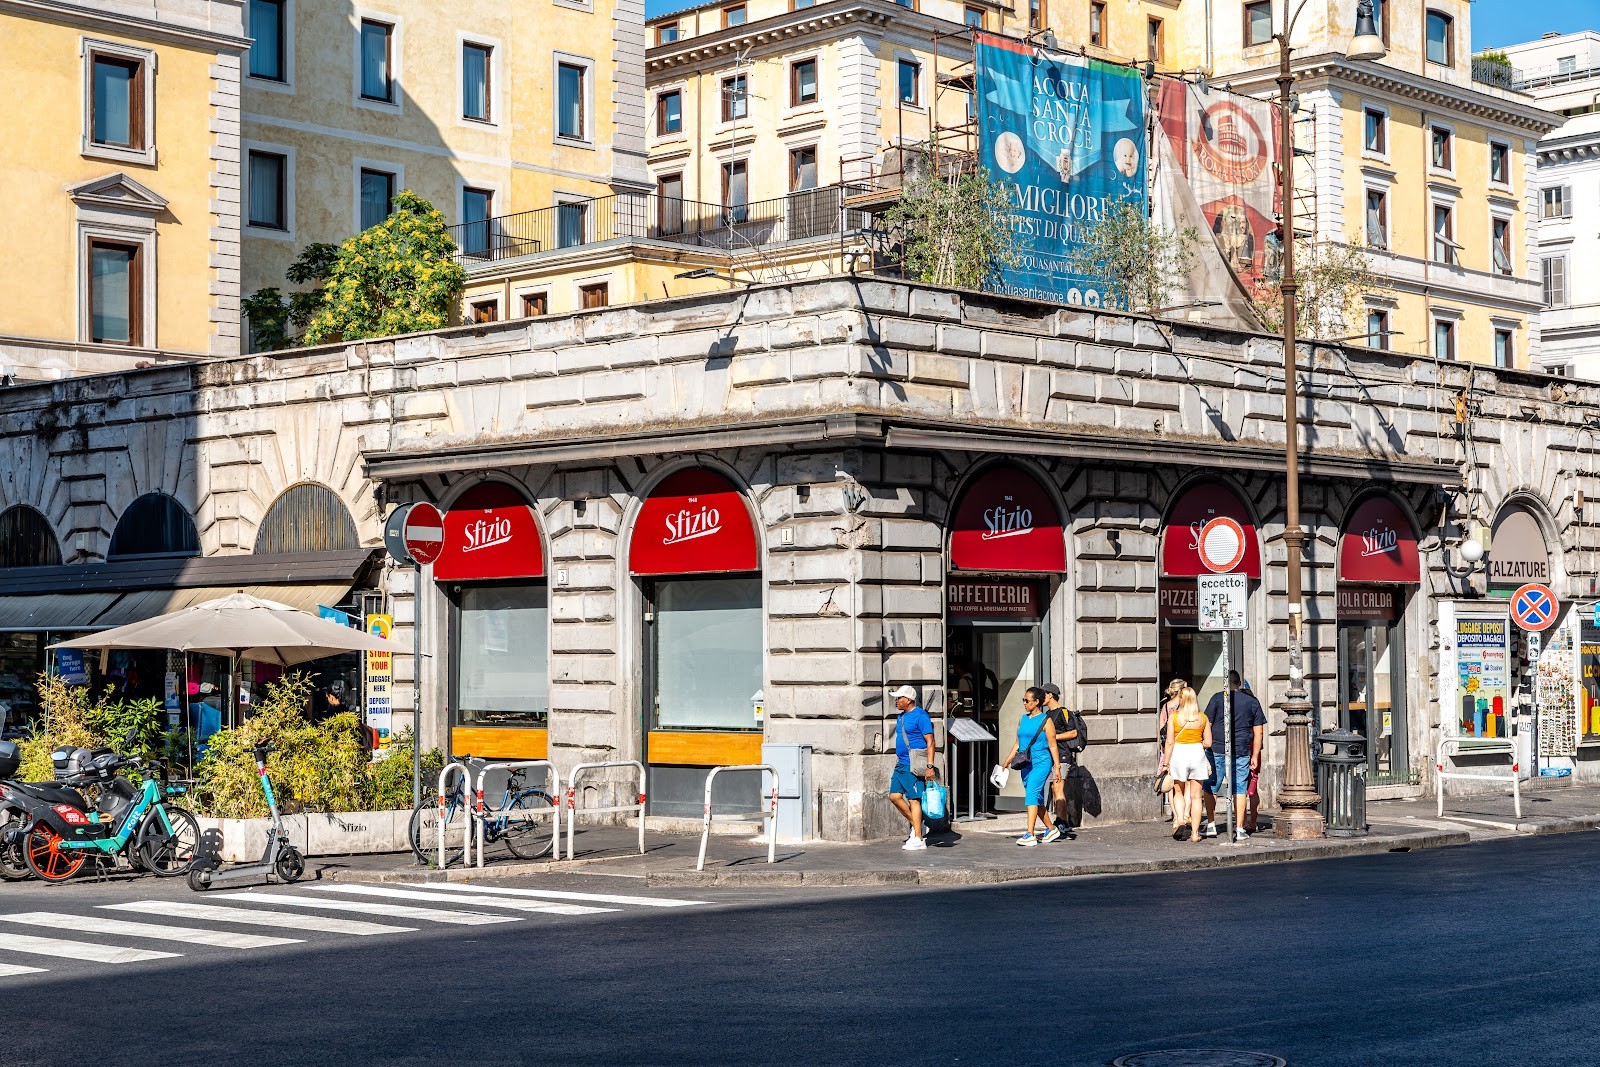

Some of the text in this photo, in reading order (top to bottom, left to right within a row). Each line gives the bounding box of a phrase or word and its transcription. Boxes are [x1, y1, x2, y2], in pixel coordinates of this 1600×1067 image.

[1033, 75, 1090, 104] ACQUA
[1033, 97, 1091, 128] SANTA
[1033, 120, 1093, 149] CROCE
[1199, 149, 1229, 181] ROMA
[1007, 214, 1042, 236] TEST
[1044, 220, 1057, 239] DI
[462, 516, 513, 552] Sfizio
[663, 506, 722, 545] Sfizio
[982, 505, 1034, 540] Sfizio
[1361, 526, 1398, 557] Sfizio
[948, 585, 1030, 603] AFFETTERIA
[1201, 576, 1244, 588] eccetto:
[1362, 592, 1393, 608] CALDA
[1457, 622, 1504, 634] LUGGAGE DEPOSIT
[1458, 634, 1504, 643] DEPOSITO BAGAGLI
[371, 661, 388, 670] YOUR
[368, 697, 390, 705] DEPOSIT
[341, 823, 367, 833] Sfizio
